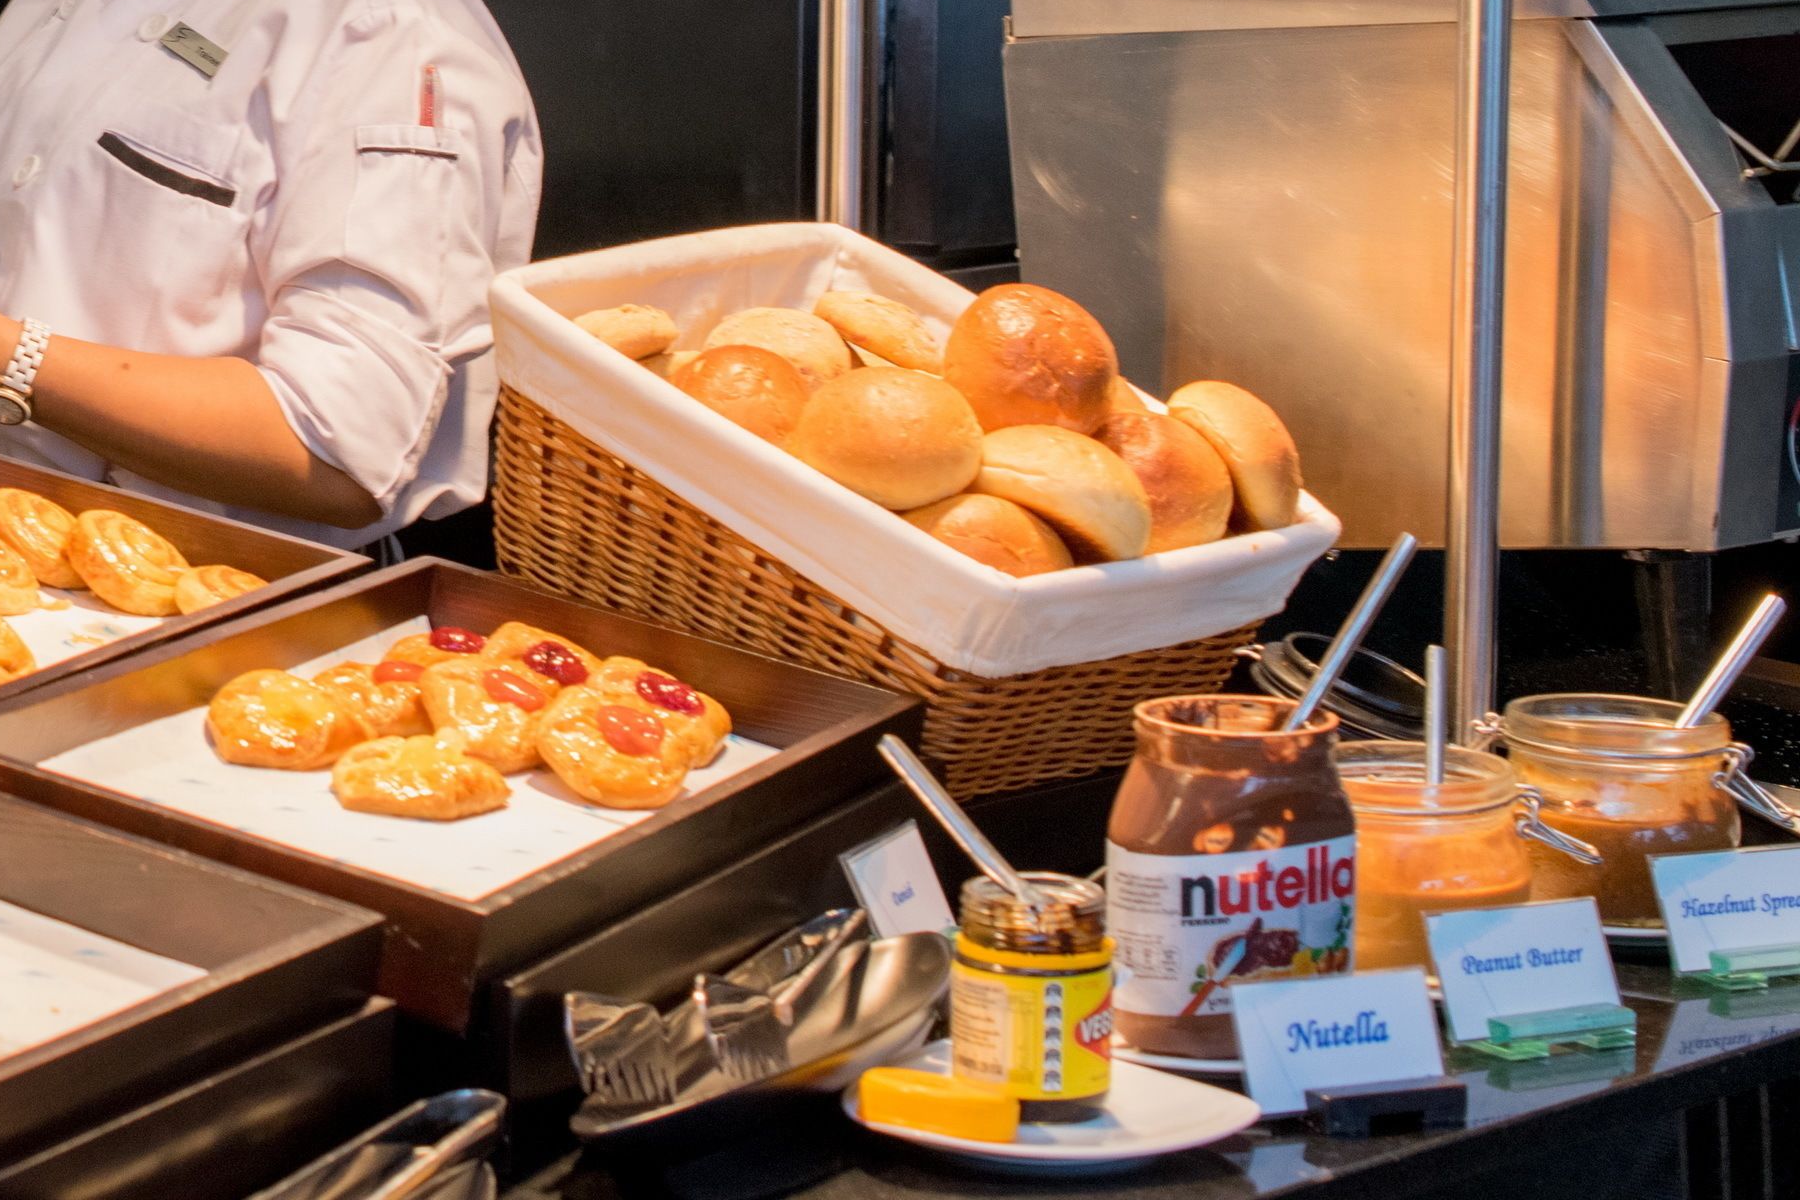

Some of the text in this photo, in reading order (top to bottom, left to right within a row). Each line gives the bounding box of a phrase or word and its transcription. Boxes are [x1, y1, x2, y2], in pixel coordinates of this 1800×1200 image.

[1181, 845, 1354, 916] nutella
[1681, 894, 1756, 918] Hazelnut
[1461, 947, 1584, 975] Peanut Butter
[1287, 1010, 1389, 1053] Nutella
